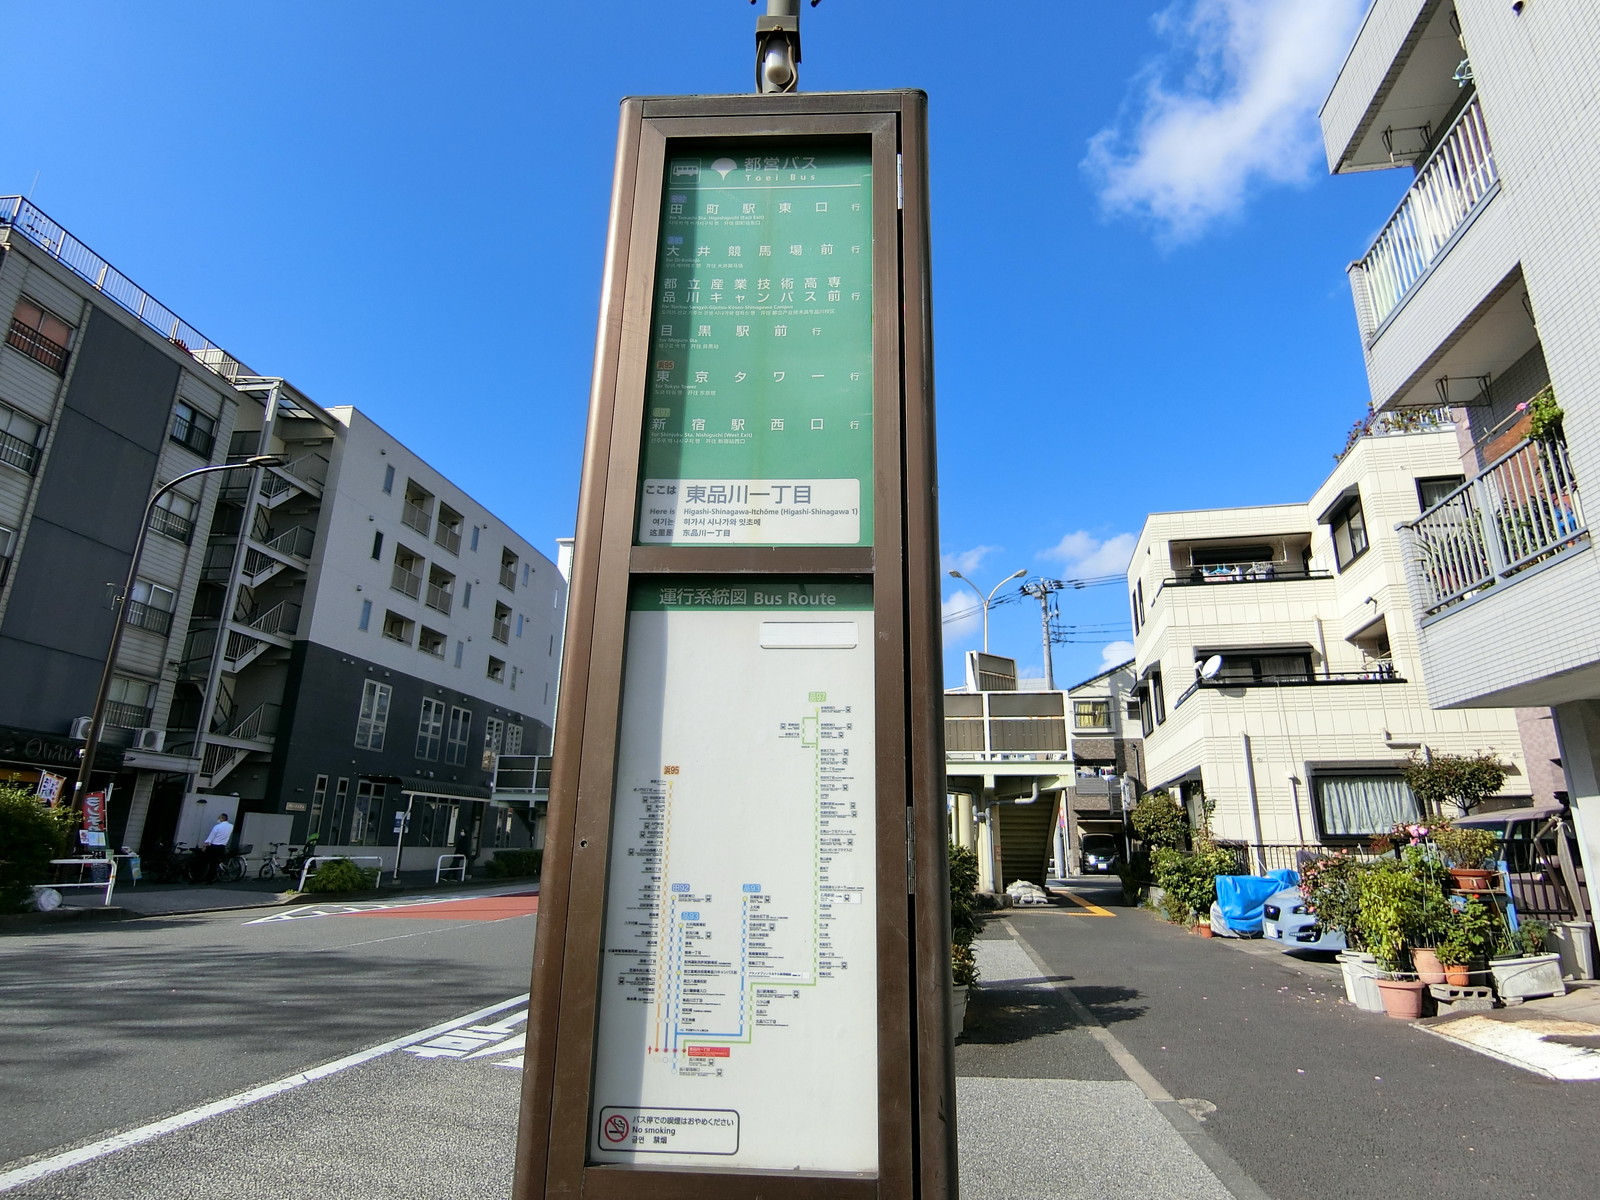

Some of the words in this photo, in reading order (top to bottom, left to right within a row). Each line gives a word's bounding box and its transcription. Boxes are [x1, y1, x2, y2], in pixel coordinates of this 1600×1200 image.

[744, 156, 817, 172] 都営バス
[745, 174, 779, 182] Toei
[790, 173, 816, 181] Bus
[646, 485, 677, 495] ここは
[685, 485, 811, 505] 東品川一丁目
[780, 508, 850, 517] (Higashi-Shinagawa
[851, 508, 858, 516] 1)
[649, 528, 674, 537] 这里是
[682, 529, 731, 537] 东品川一丁目
[659, 587, 747, 605] 運行系統図
[753, 592, 783, 605] Bus
[788, 591, 837, 605] Route
[632, 1115, 734, 1127] バス停での喫煙はおやめください
[644, 1126, 676, 1136] smoking
